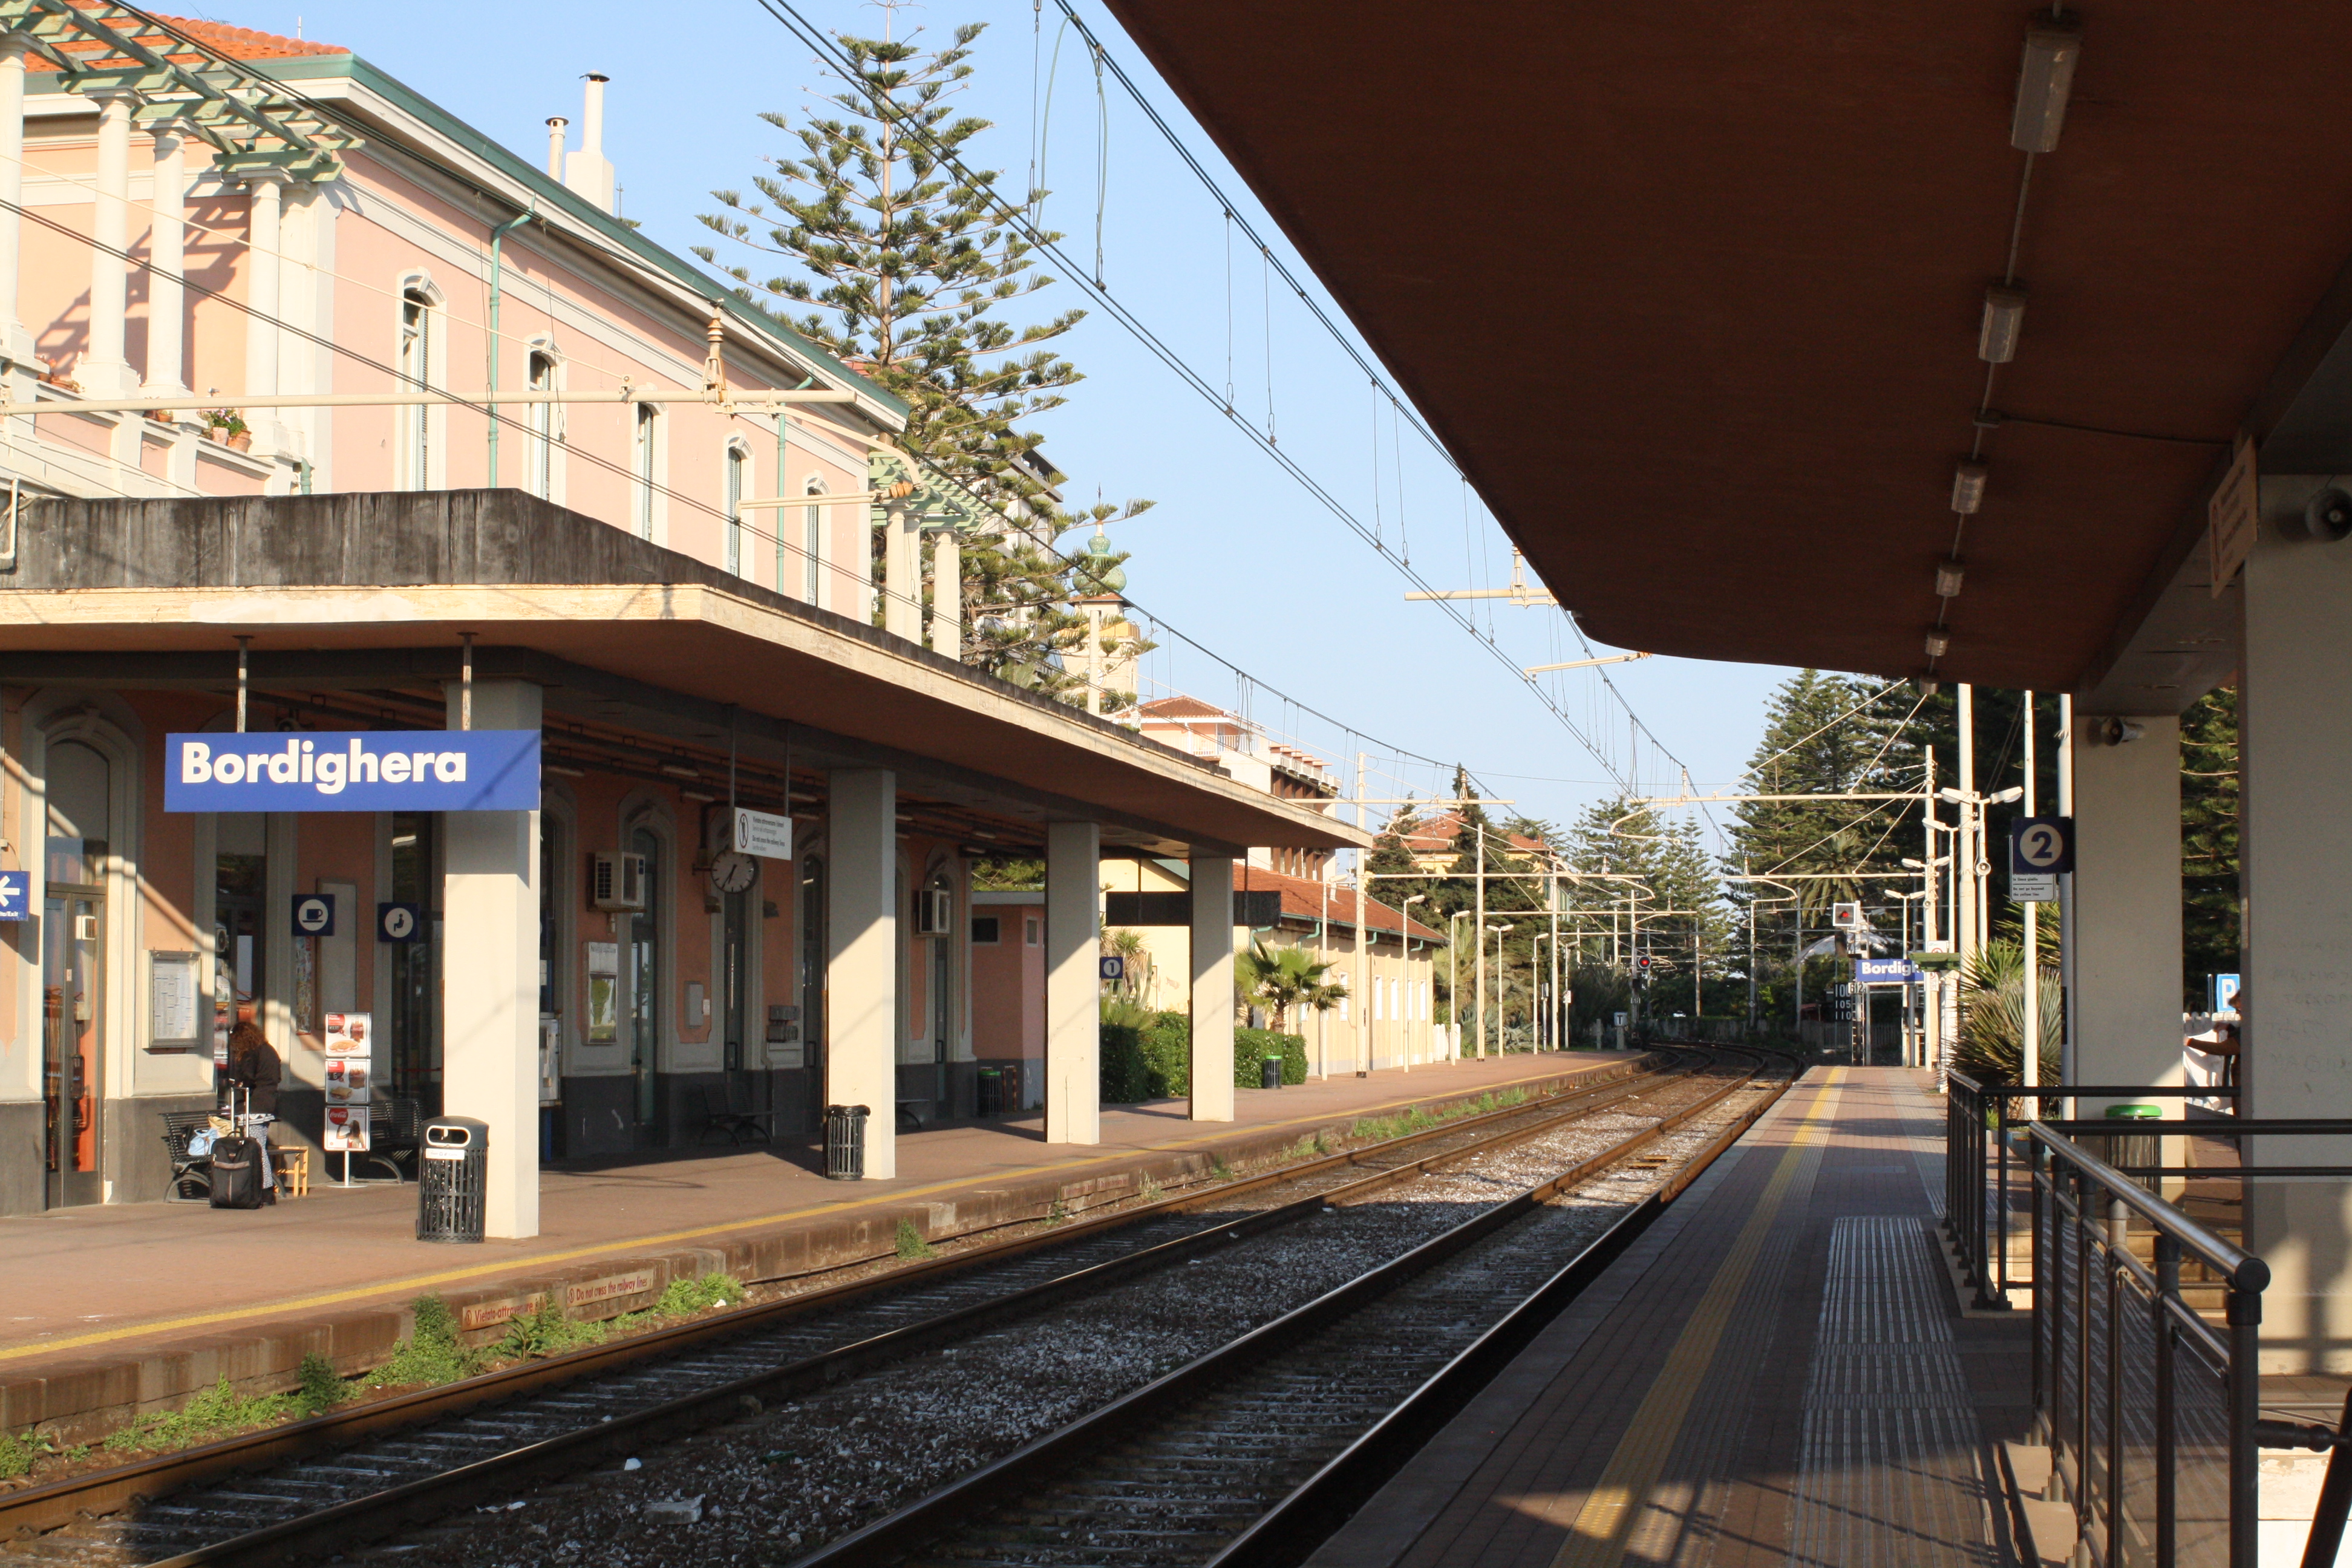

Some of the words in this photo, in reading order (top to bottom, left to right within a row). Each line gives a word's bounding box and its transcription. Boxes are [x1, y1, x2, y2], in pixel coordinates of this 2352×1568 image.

[183, 739, 466, 794] Bordighera
[2031, 831, 2052, 858] 2
[1109, 962, 1114, 973] 1
[1861, 960, 1920, 976] Bordigh
[2222, 978, 2236, 1008] P
[1835, 1000, 1851, 1009] 105
[1617, 1015, 1622, 1024] T
[1835, 1011, 1851, 1020] 110
[577, 1288, 584, 1301] Do
[594, 1285, 607, 1297] cross
[608, 1281, 616, 1294] the
[617, 1278, 635, 1292] railway
[636, 1276, 647, 1288] lines
[475, 1308, 495, 1323] Vietato
